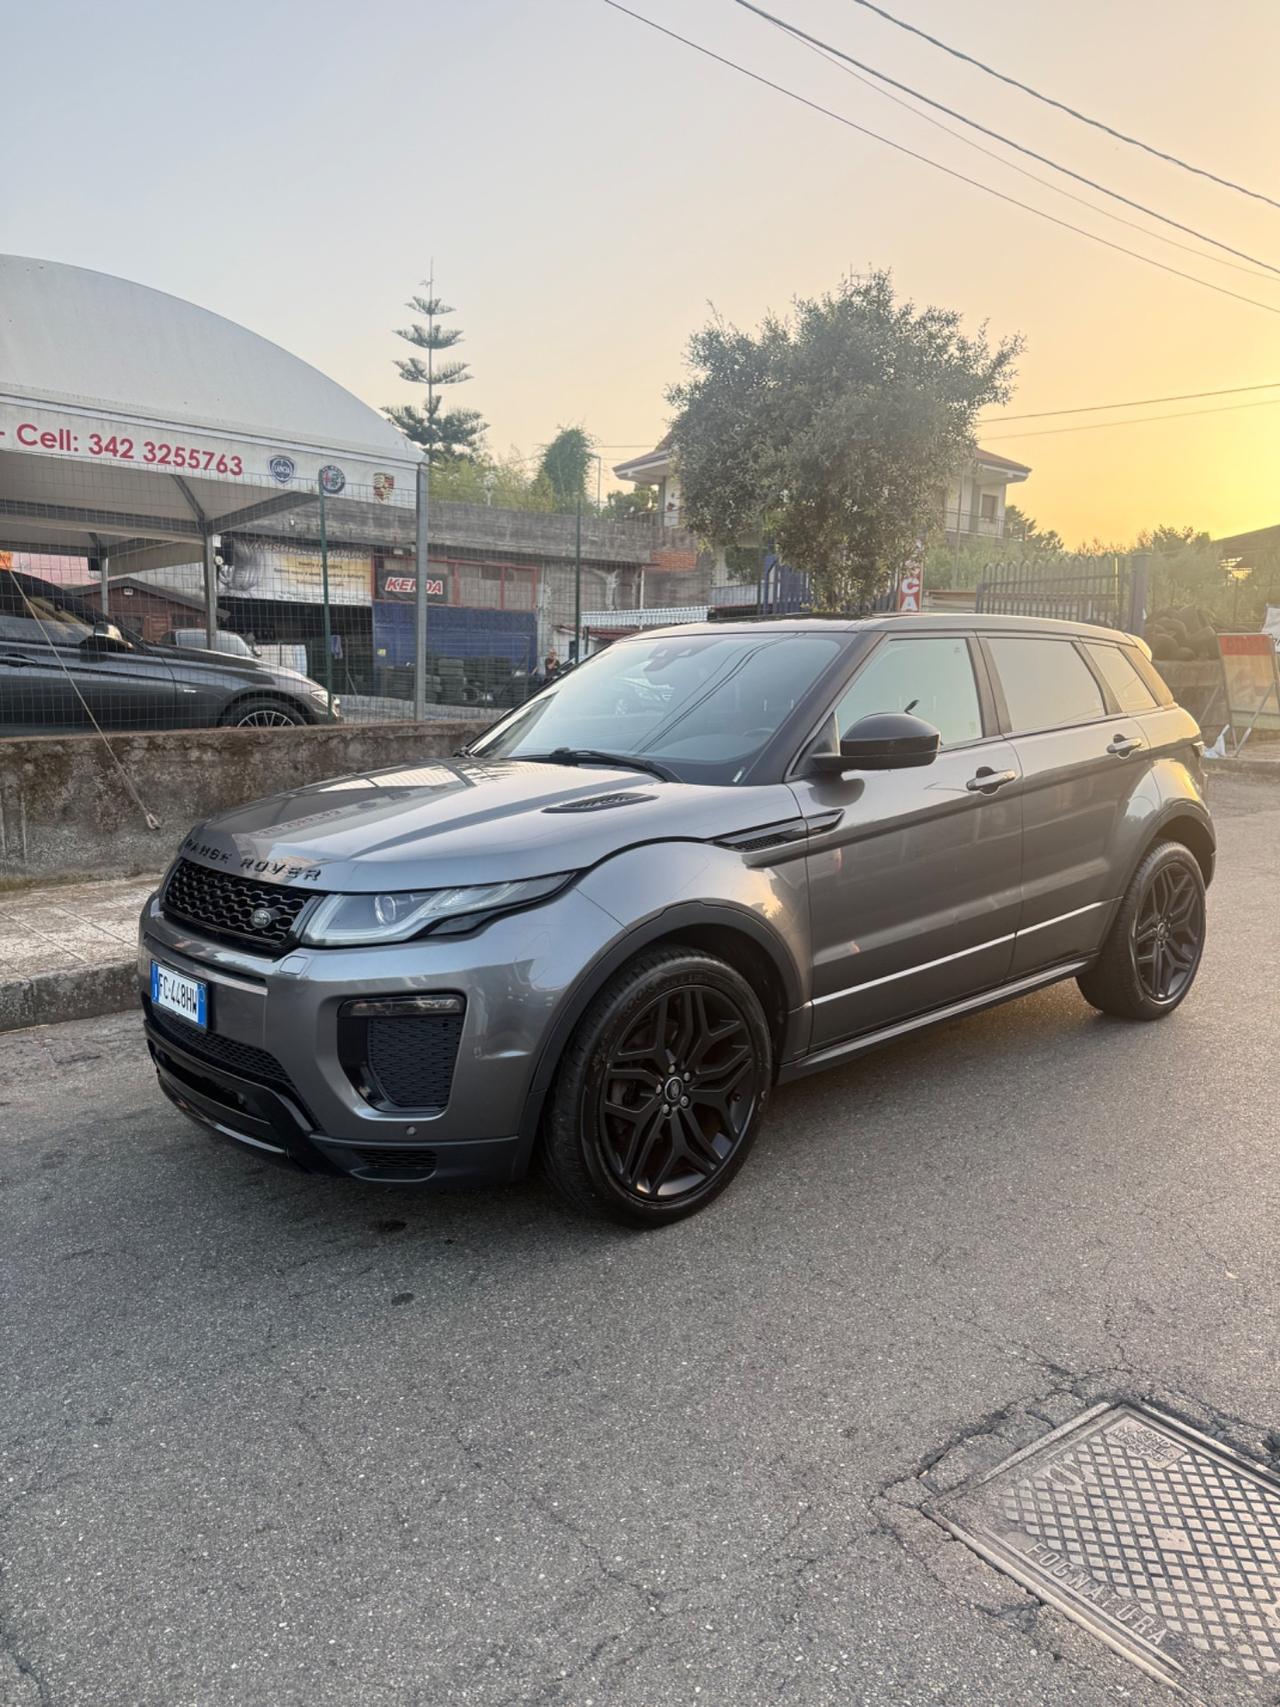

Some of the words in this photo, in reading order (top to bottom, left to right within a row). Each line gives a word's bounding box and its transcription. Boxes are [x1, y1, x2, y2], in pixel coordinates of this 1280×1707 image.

[17, 423, 79, 452] Cell:
[89, 434, 134, 459] 342
[143, 441, 243, 476] 3255763
[240, 857, 321, 881] ROVER
[1025, 1543, 1167, 1645] FOGNATURA
